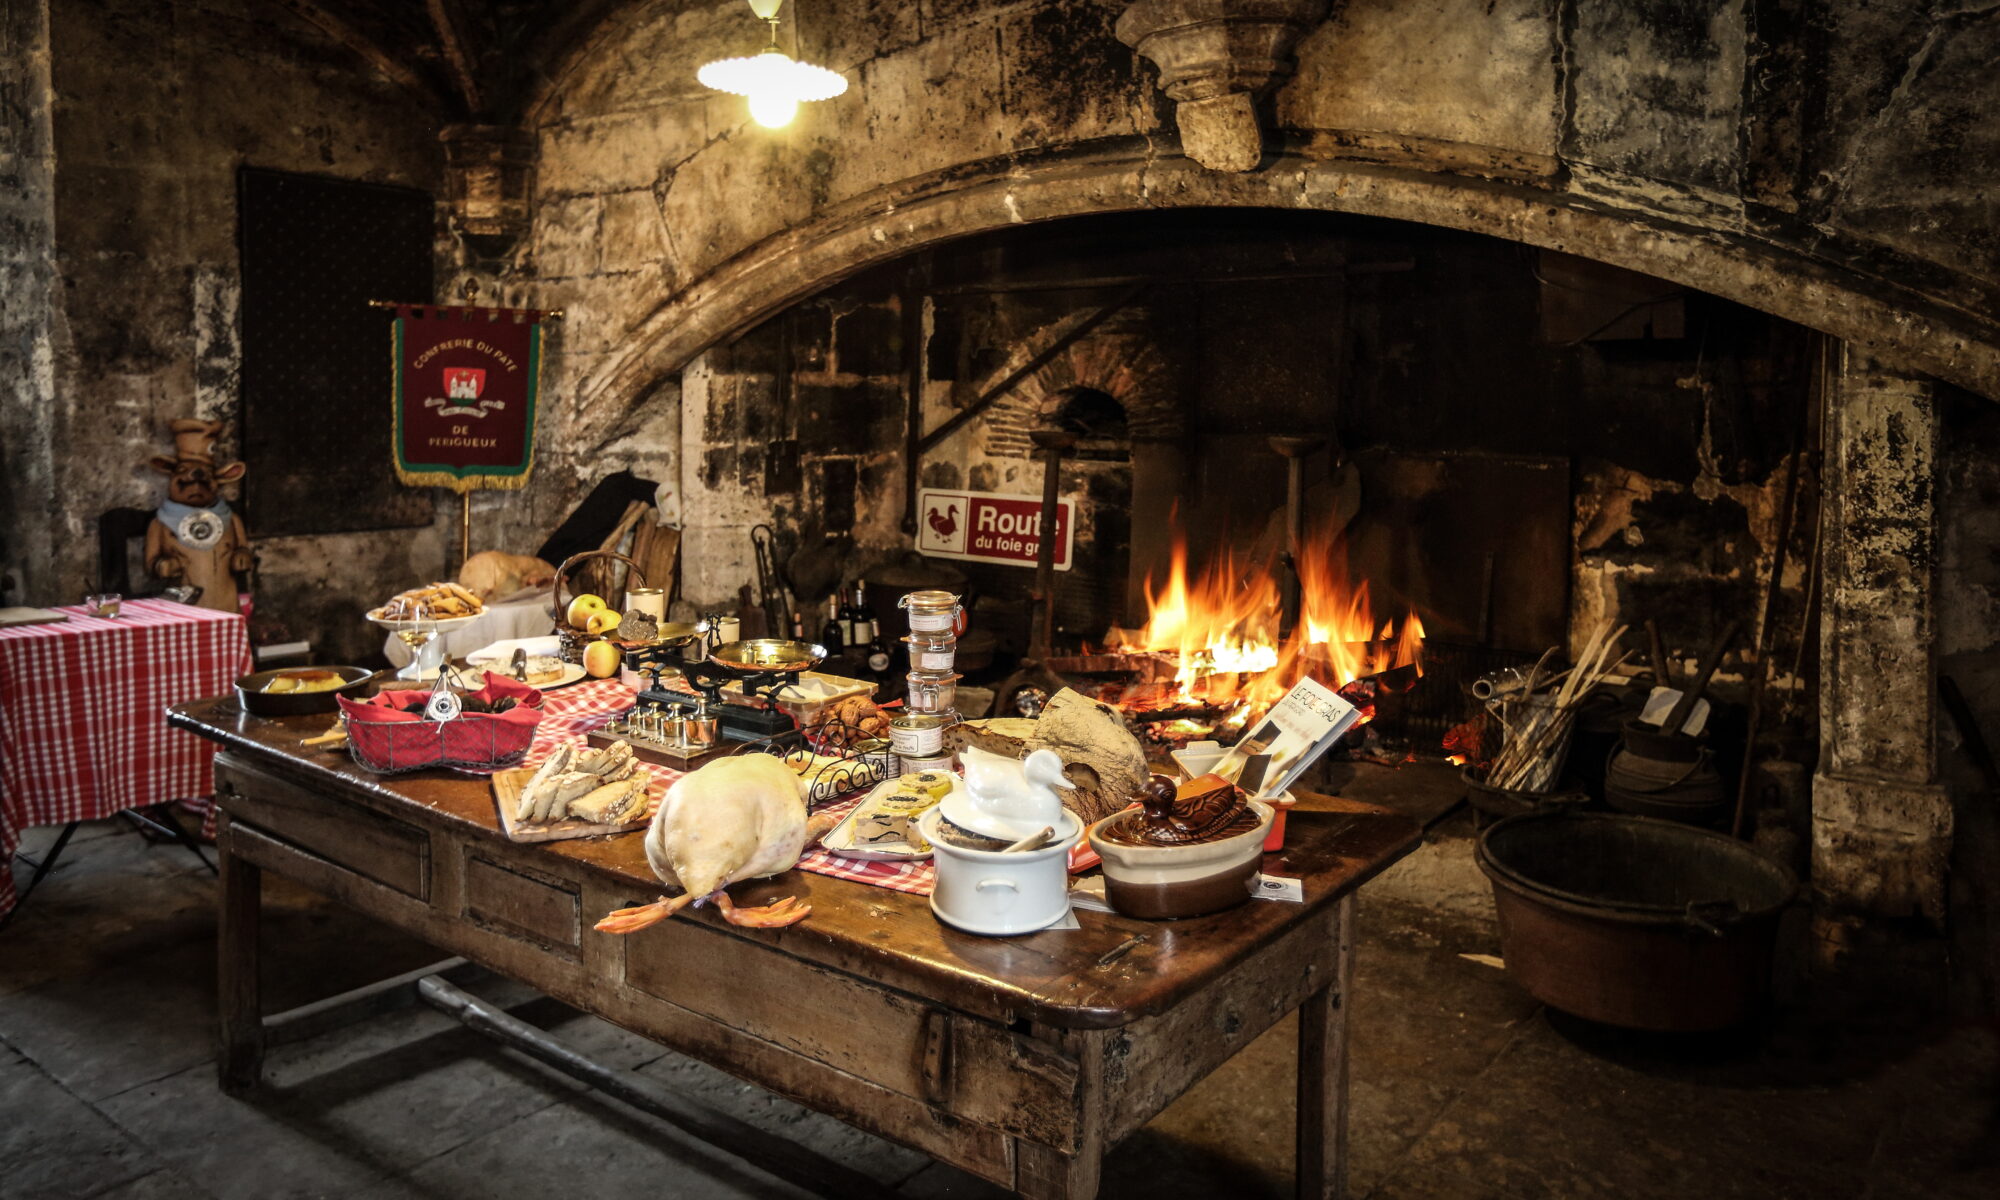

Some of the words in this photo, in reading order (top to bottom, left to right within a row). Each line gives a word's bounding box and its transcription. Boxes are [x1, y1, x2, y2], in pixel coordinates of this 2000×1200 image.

[476, 341, 494, 354] DU
[452, 425, 469, 435] DE
[975, 535, 992, 549] du
[996, 537, 1021, 552] foie
[1291, 686, 1306, 700] LE
[1299, 690, 1322, 710] FOIE
[1316, 701, 1341, 722] GRAS
